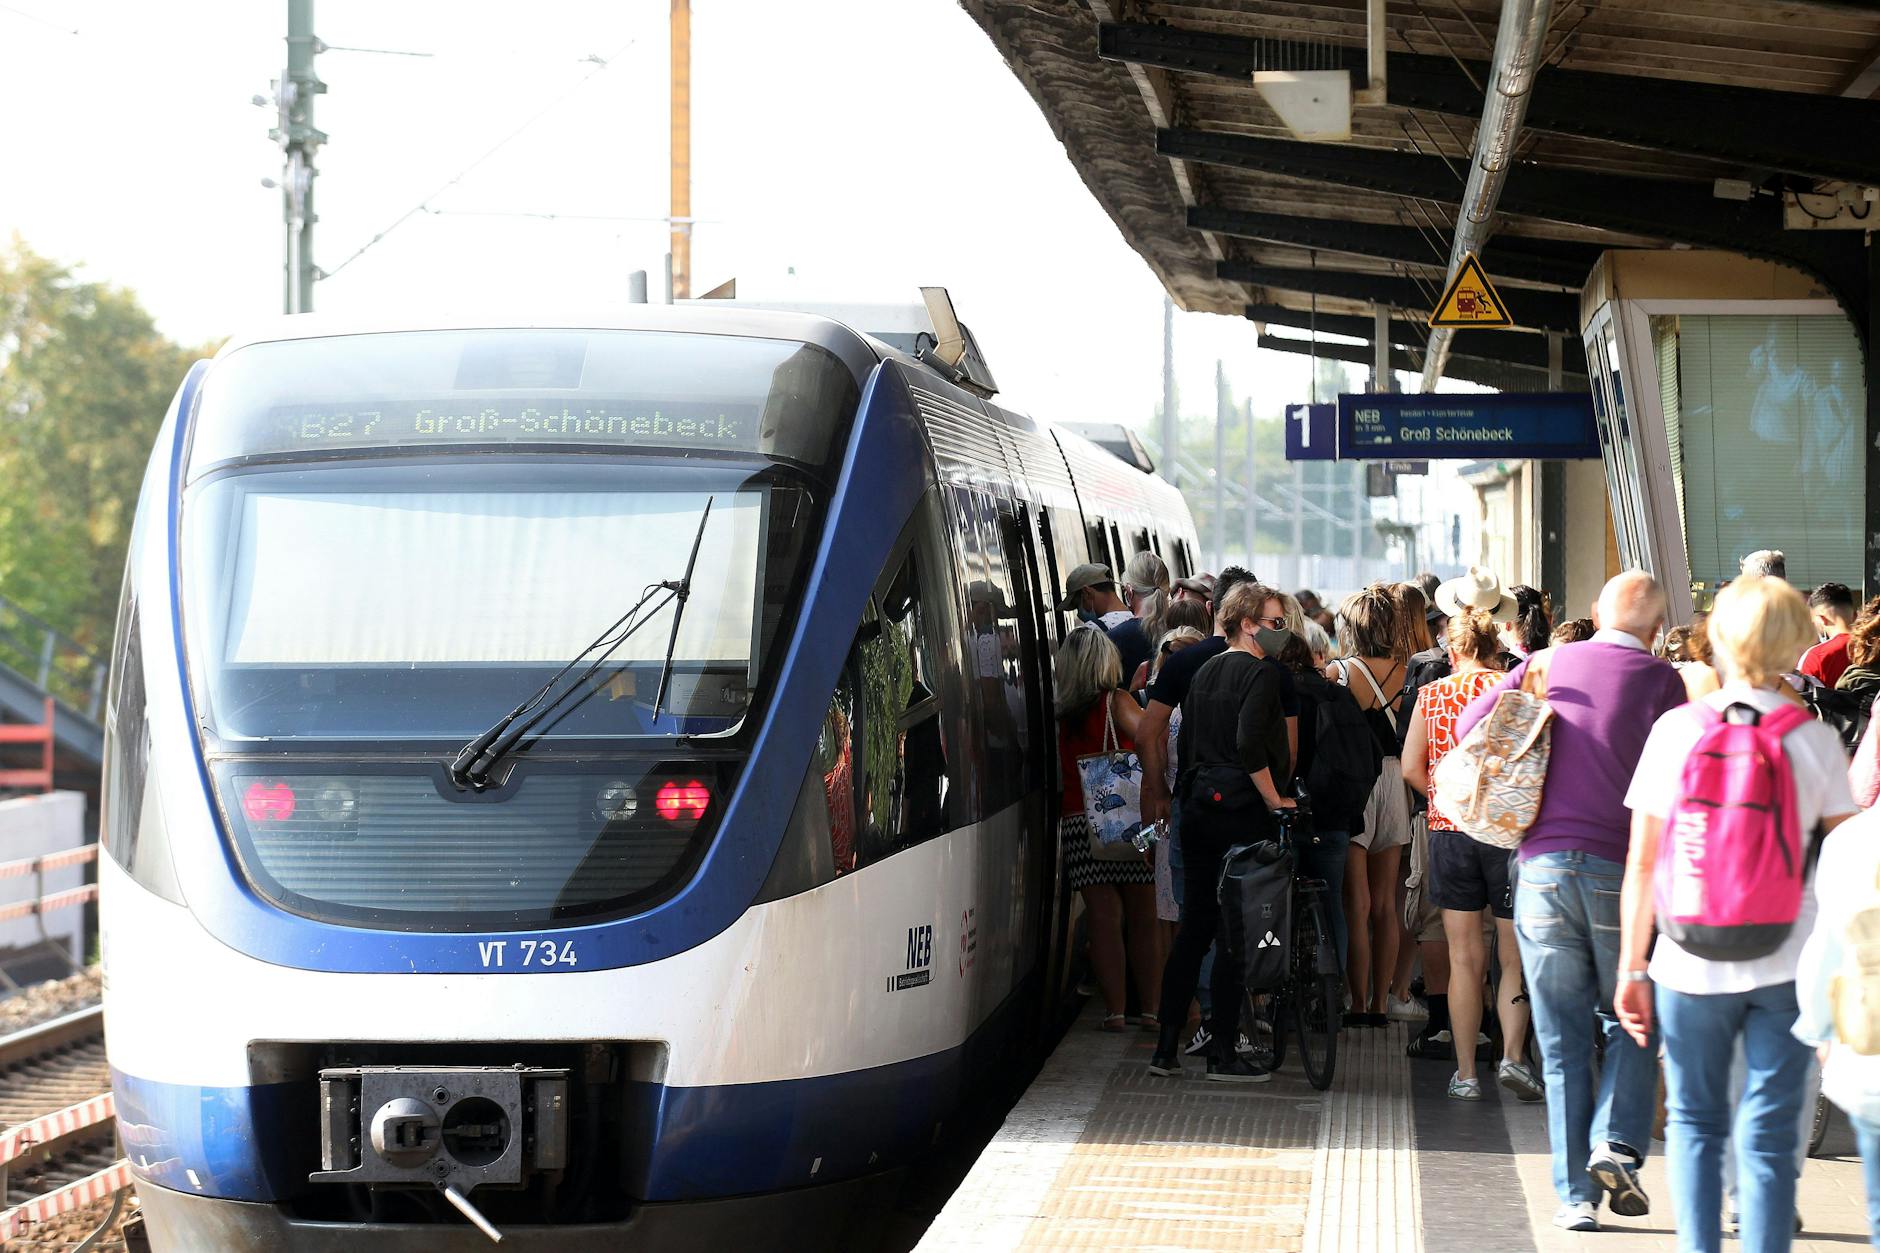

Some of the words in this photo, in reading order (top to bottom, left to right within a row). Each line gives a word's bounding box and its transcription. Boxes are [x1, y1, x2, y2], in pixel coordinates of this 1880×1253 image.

[415, 408, 739, 439] Groß-Schönebeck
[1292, 405, 1311, 448] 1
[1355, 408, 1380, 424] NEB
[1400, 426, 1431, 441] Groß
[1436, 426, 1513, 441] Schönebeck
[478, 941, 507, 967] VT
[520, 940, 577, 966] 734
[906, 924, 932, 970] NEB
